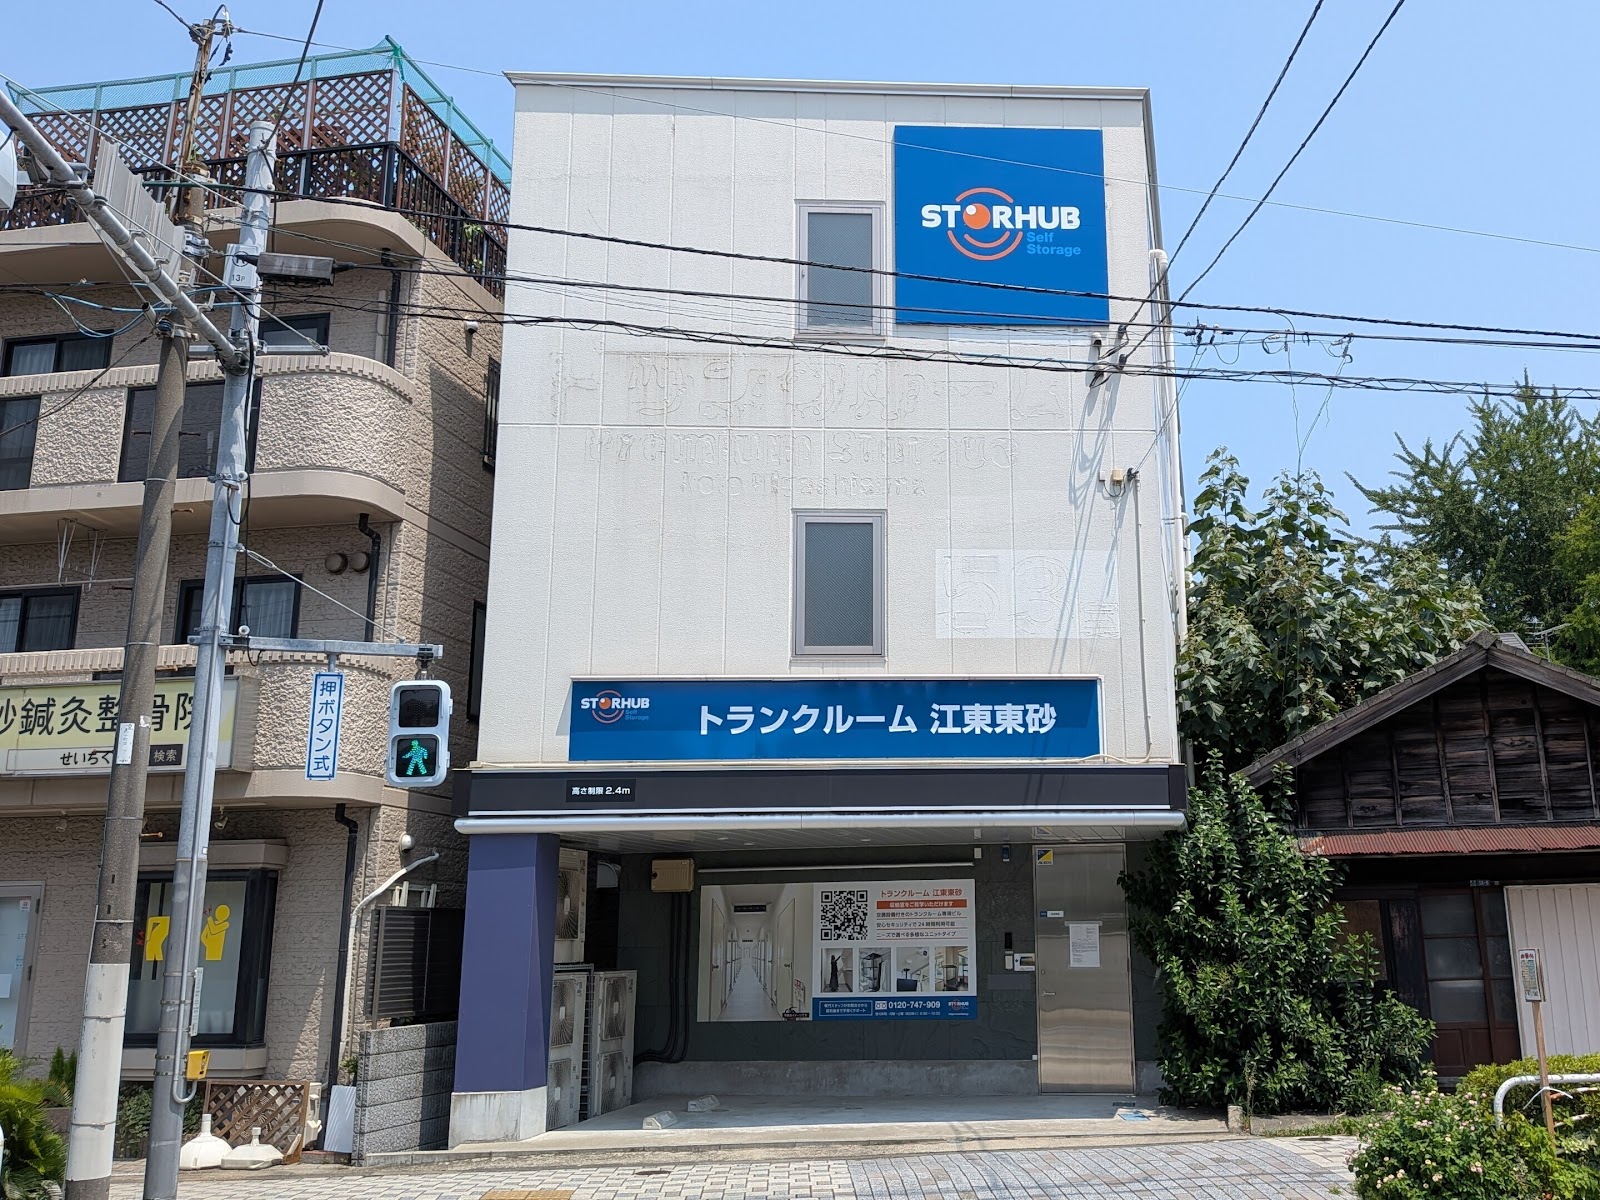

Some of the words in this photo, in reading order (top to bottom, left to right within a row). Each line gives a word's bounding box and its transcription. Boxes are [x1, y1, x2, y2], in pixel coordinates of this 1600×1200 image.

[921, 203, 1081, 229] STORHUB
[1026, 231, 1054, 243] Self
[1026, 243, 1081, 257] Storage
[580, 697, 650, 709] STORHUB
[313, 680, 337, 771] 押ボタン式
[699, 704, 918, 736] トランクルーム
[929, 703, 1057, 735] 江東東砂
[153, 748, 178, 763] 検索
[571, 786, 604, 796] 高さ制限
[605, 786, 631, 795] 2.4m
[881, 889, 930, 898] トランクルーム
[932, 888, 963, 898] 江東東砂
[888, 1001, 941, 1009] 0120-747-909
